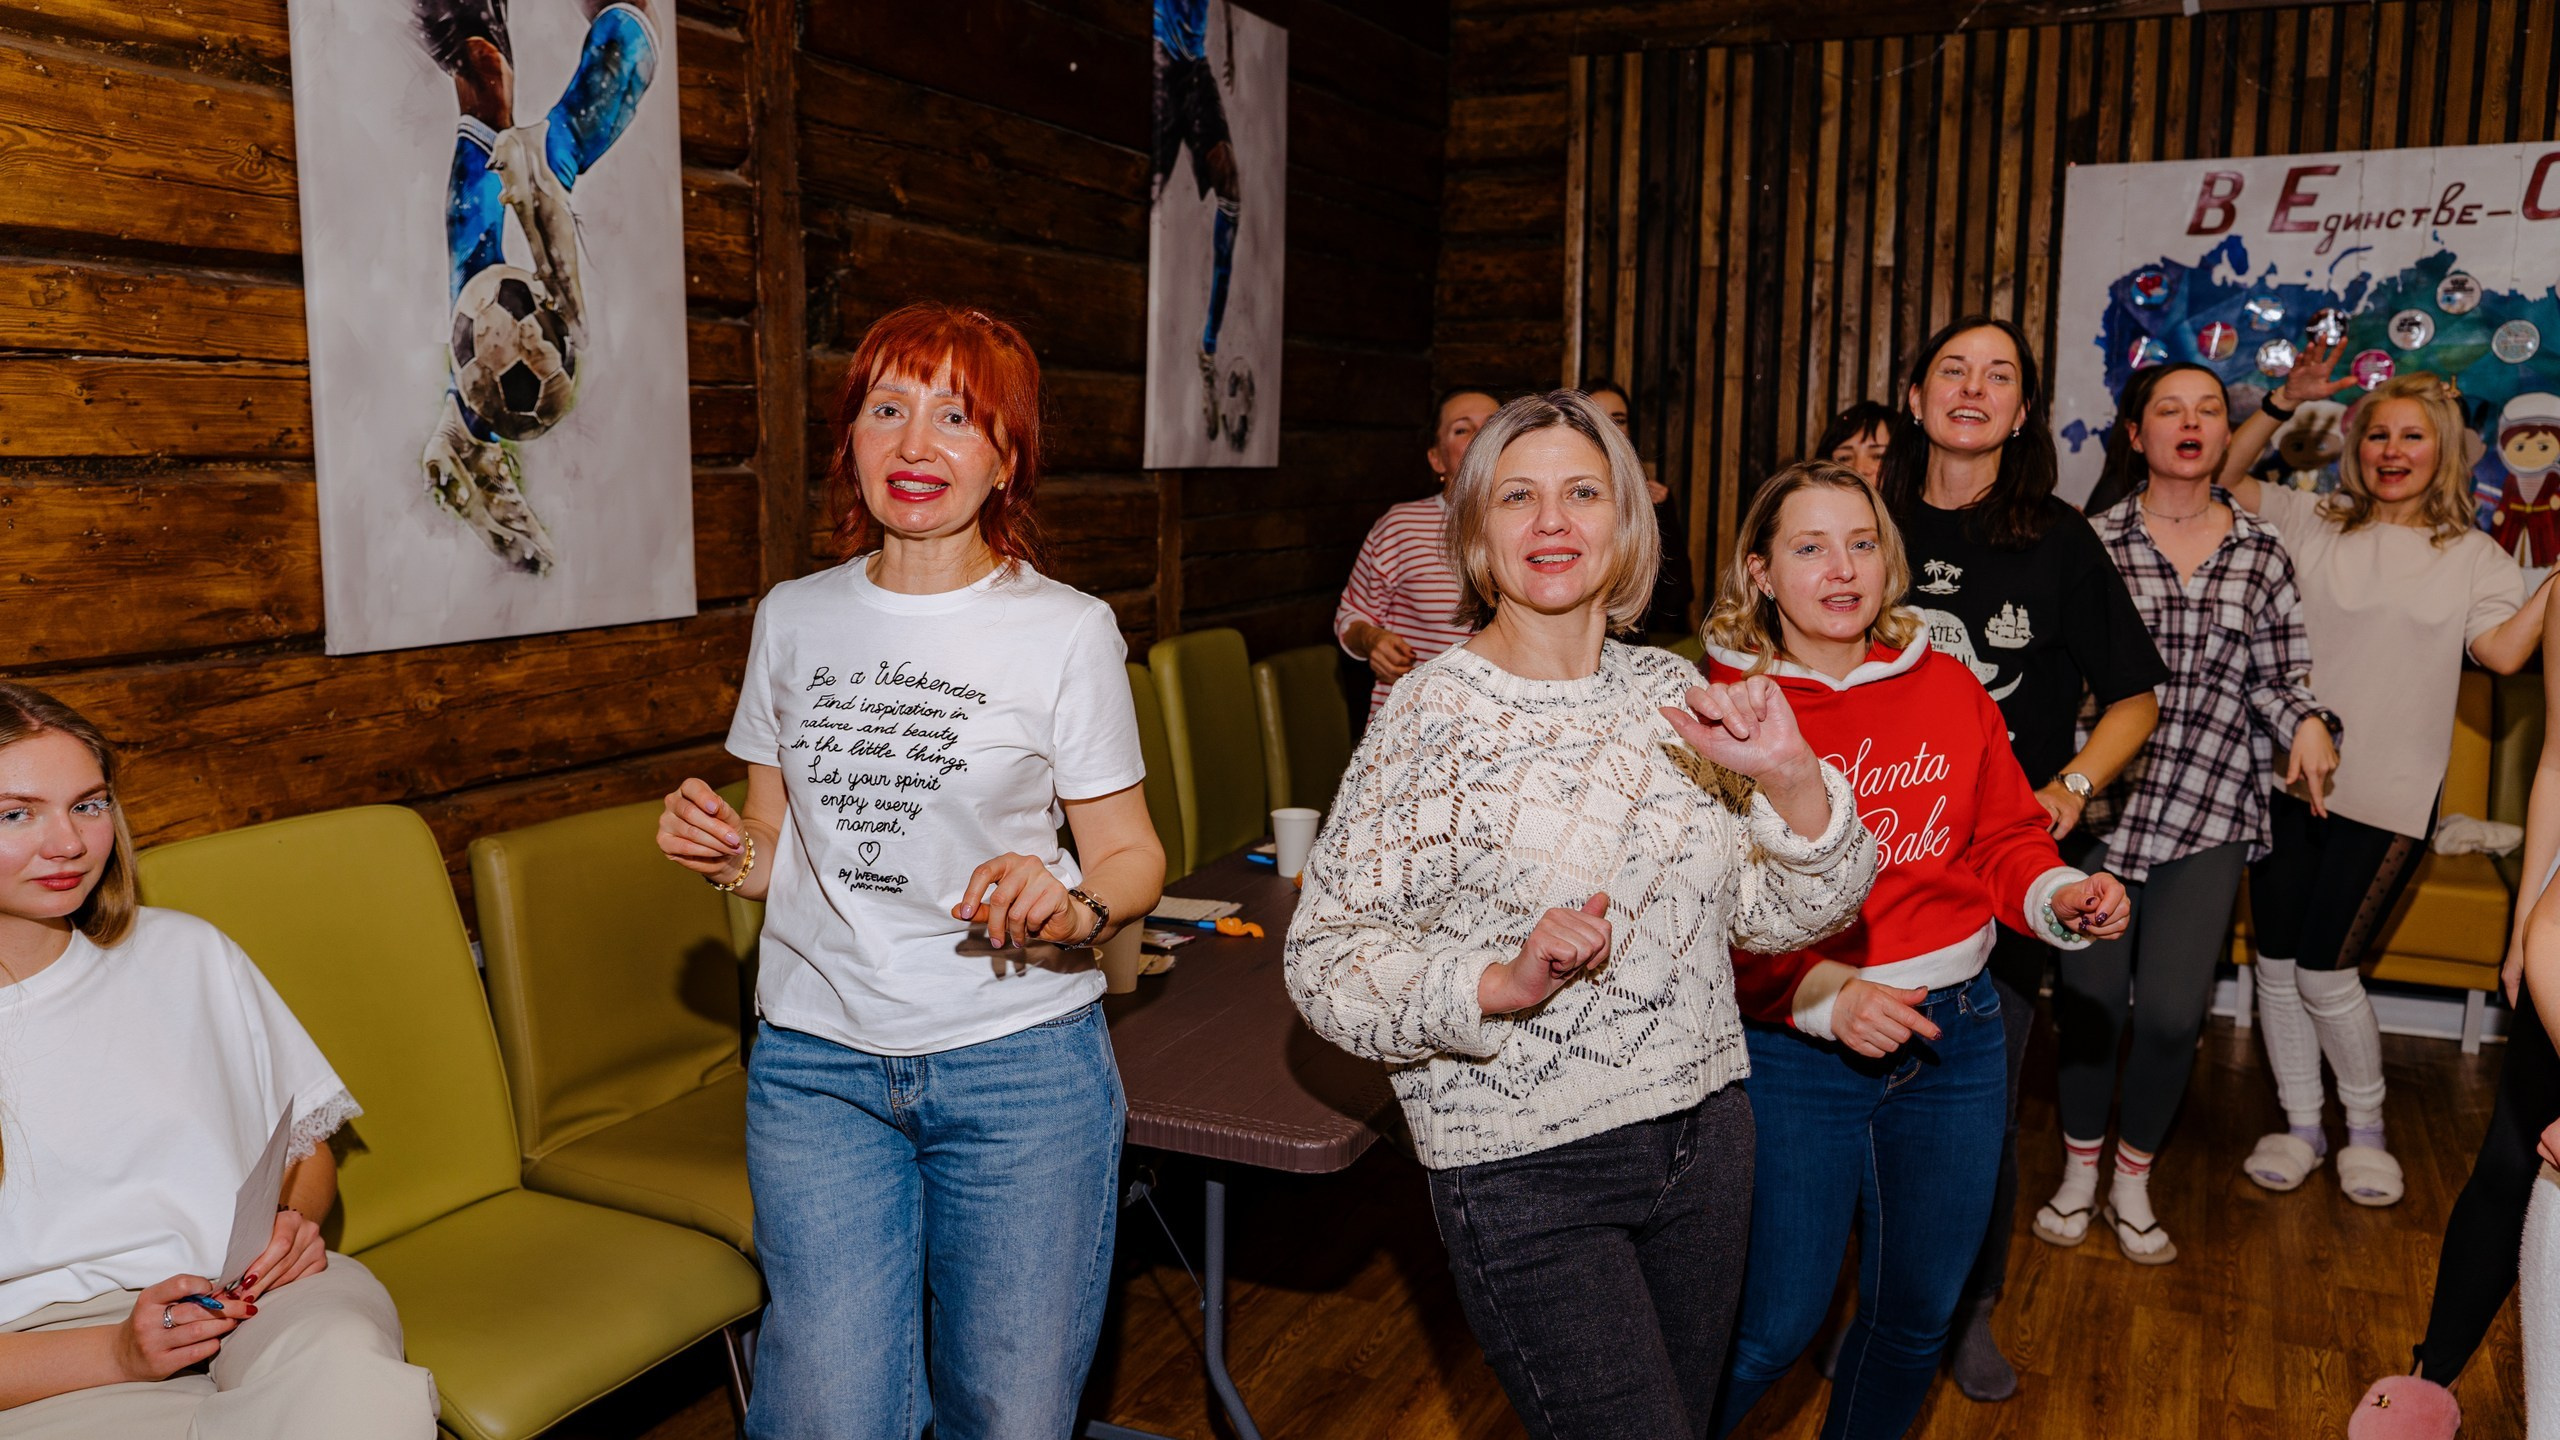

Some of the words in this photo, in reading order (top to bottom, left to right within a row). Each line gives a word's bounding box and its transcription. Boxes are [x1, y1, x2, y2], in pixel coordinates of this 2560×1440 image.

[2186, 171, 2244, 236] В
[1929, 625, 1963, 644] ATES
[806, 666, 837, 691] Be
[850, 671, 866, 685] a
[875, 661, 987, 705] Weekender
[812, 694, 857, 710] Find
[859, 698, 946, 720] inspiration
[949, 706, 969, 720] in
[800, 716, 853, 731] nature
[856, 722, 896, 735] and
[902, 723, 959, 749] beauty
[790, 735, 810, 750] in
[815, 736, 843, 752] the
[848, 739, 896, 759] little
[905, 743, 968, 775] things.
[808, 755, 842, 785] Let
[847, 772, 891, 791] your
[894, 772, 941, 793] spirit
[1822, 737, 1950, 797] Santa
[820, 793, 869, 815] enjoy
[874, 798, 923, 820] every
[836, 817, 906, 836] moment.
[1860, 795, 1950, 873] Babe
